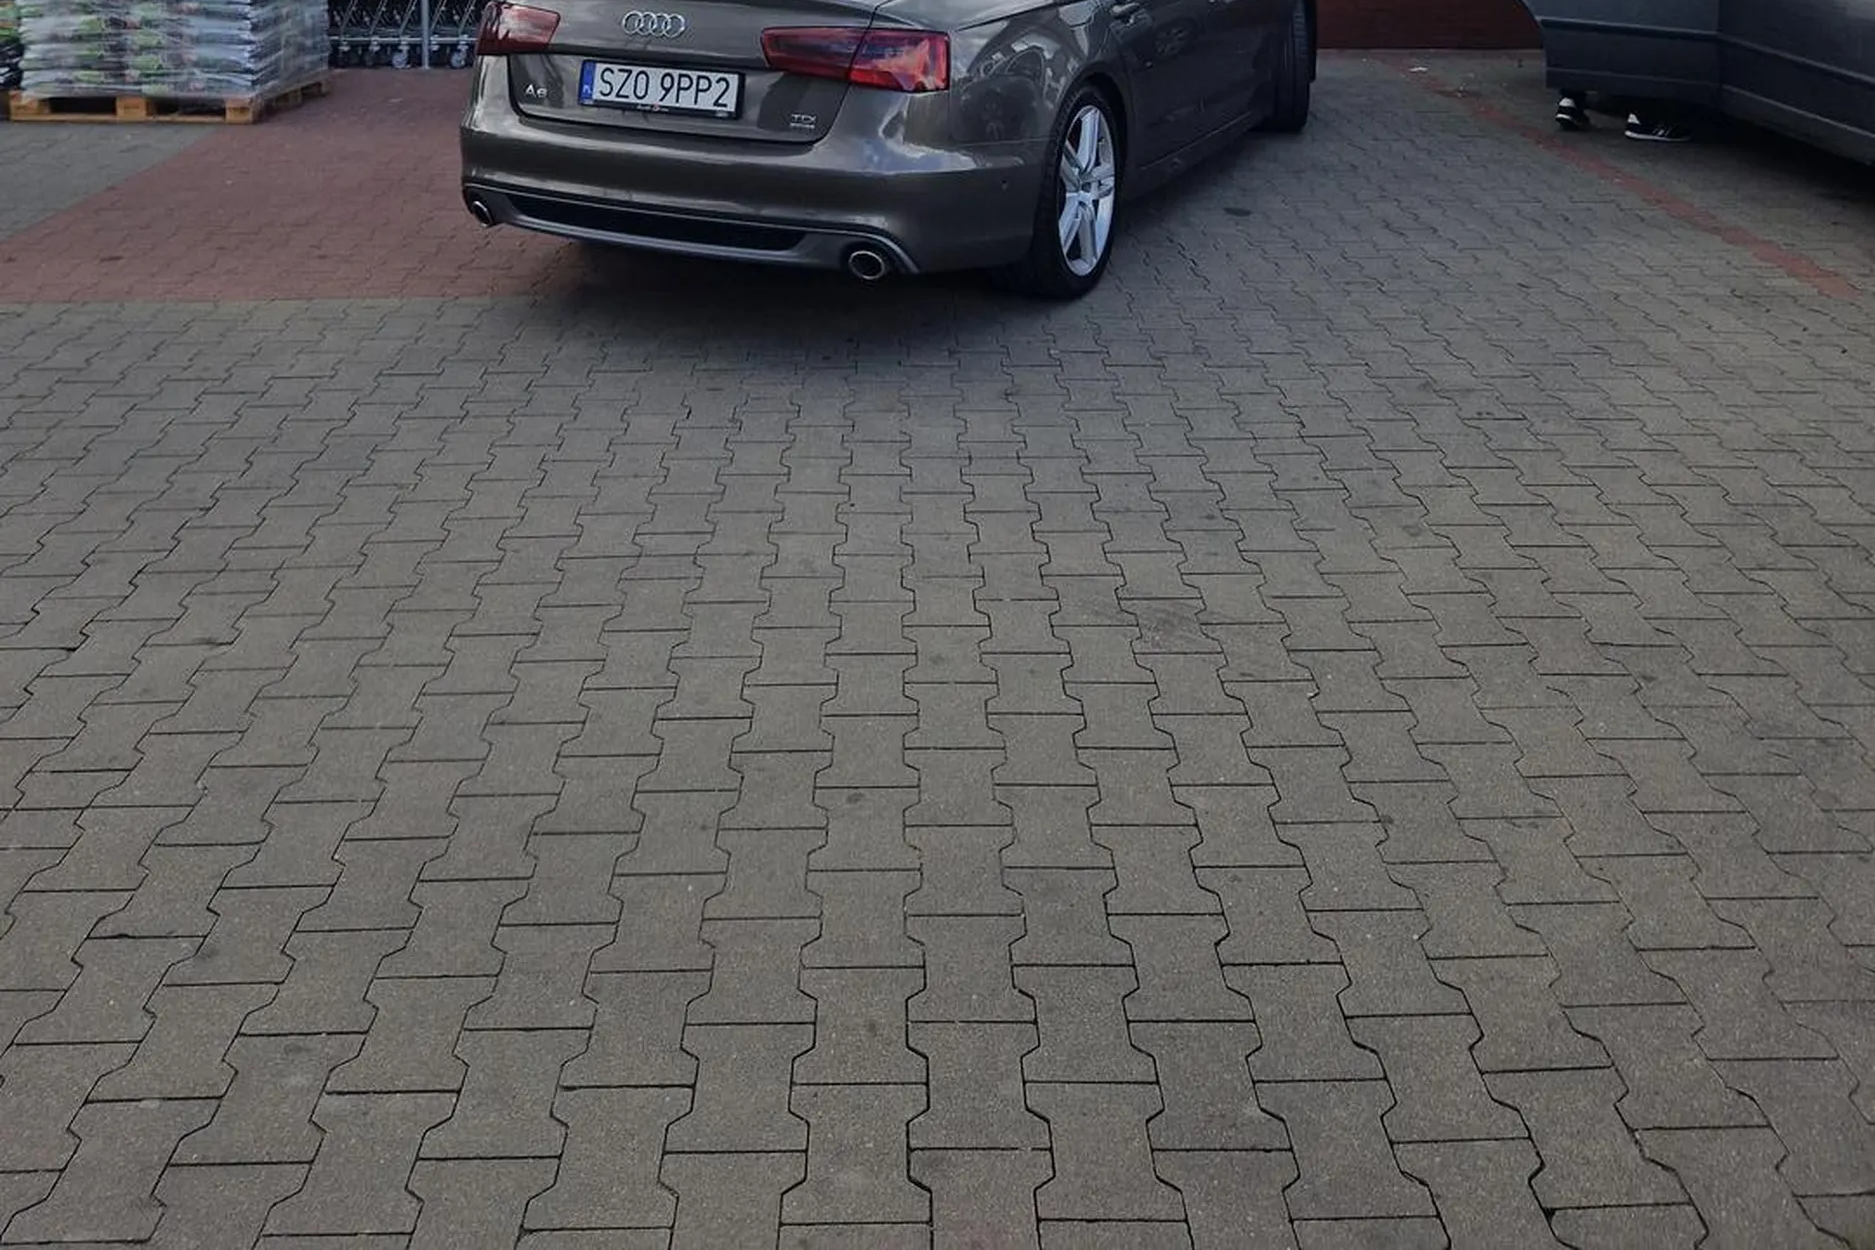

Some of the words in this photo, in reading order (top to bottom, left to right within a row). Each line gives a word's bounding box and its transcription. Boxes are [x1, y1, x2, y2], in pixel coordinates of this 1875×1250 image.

[525, 84, 548, 99] A6
[599, 67, 650, 100] SZO
[659, 72, 731, 108] 9PP2
